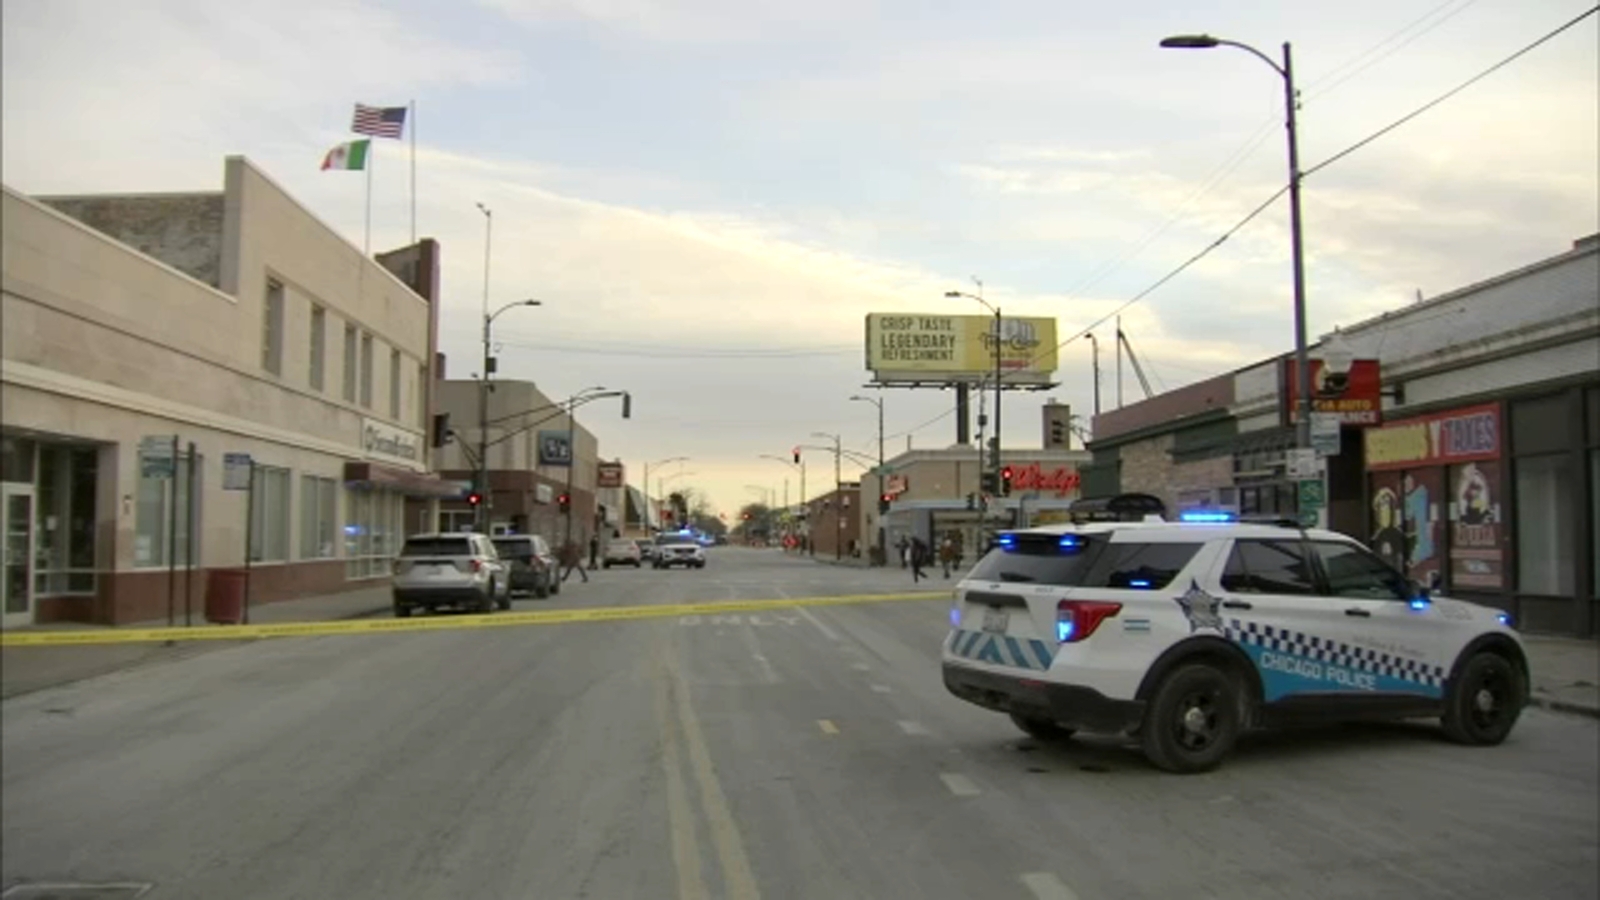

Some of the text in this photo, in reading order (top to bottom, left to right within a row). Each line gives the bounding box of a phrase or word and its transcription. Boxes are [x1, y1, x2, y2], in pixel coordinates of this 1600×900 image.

[881, 316, 913, 331] CRISP
[881, 333, 955, 349] LEGENDARY
[881, 349, 954, 361] REFRESHMENT
[1338, 400, 1373, 411] AUTO
[1441, 412, 1496, 456] TAXES
[679, 614, 800, 626] ONLY
[1260, 652, 1377, 692] CHICAGO POLICE
